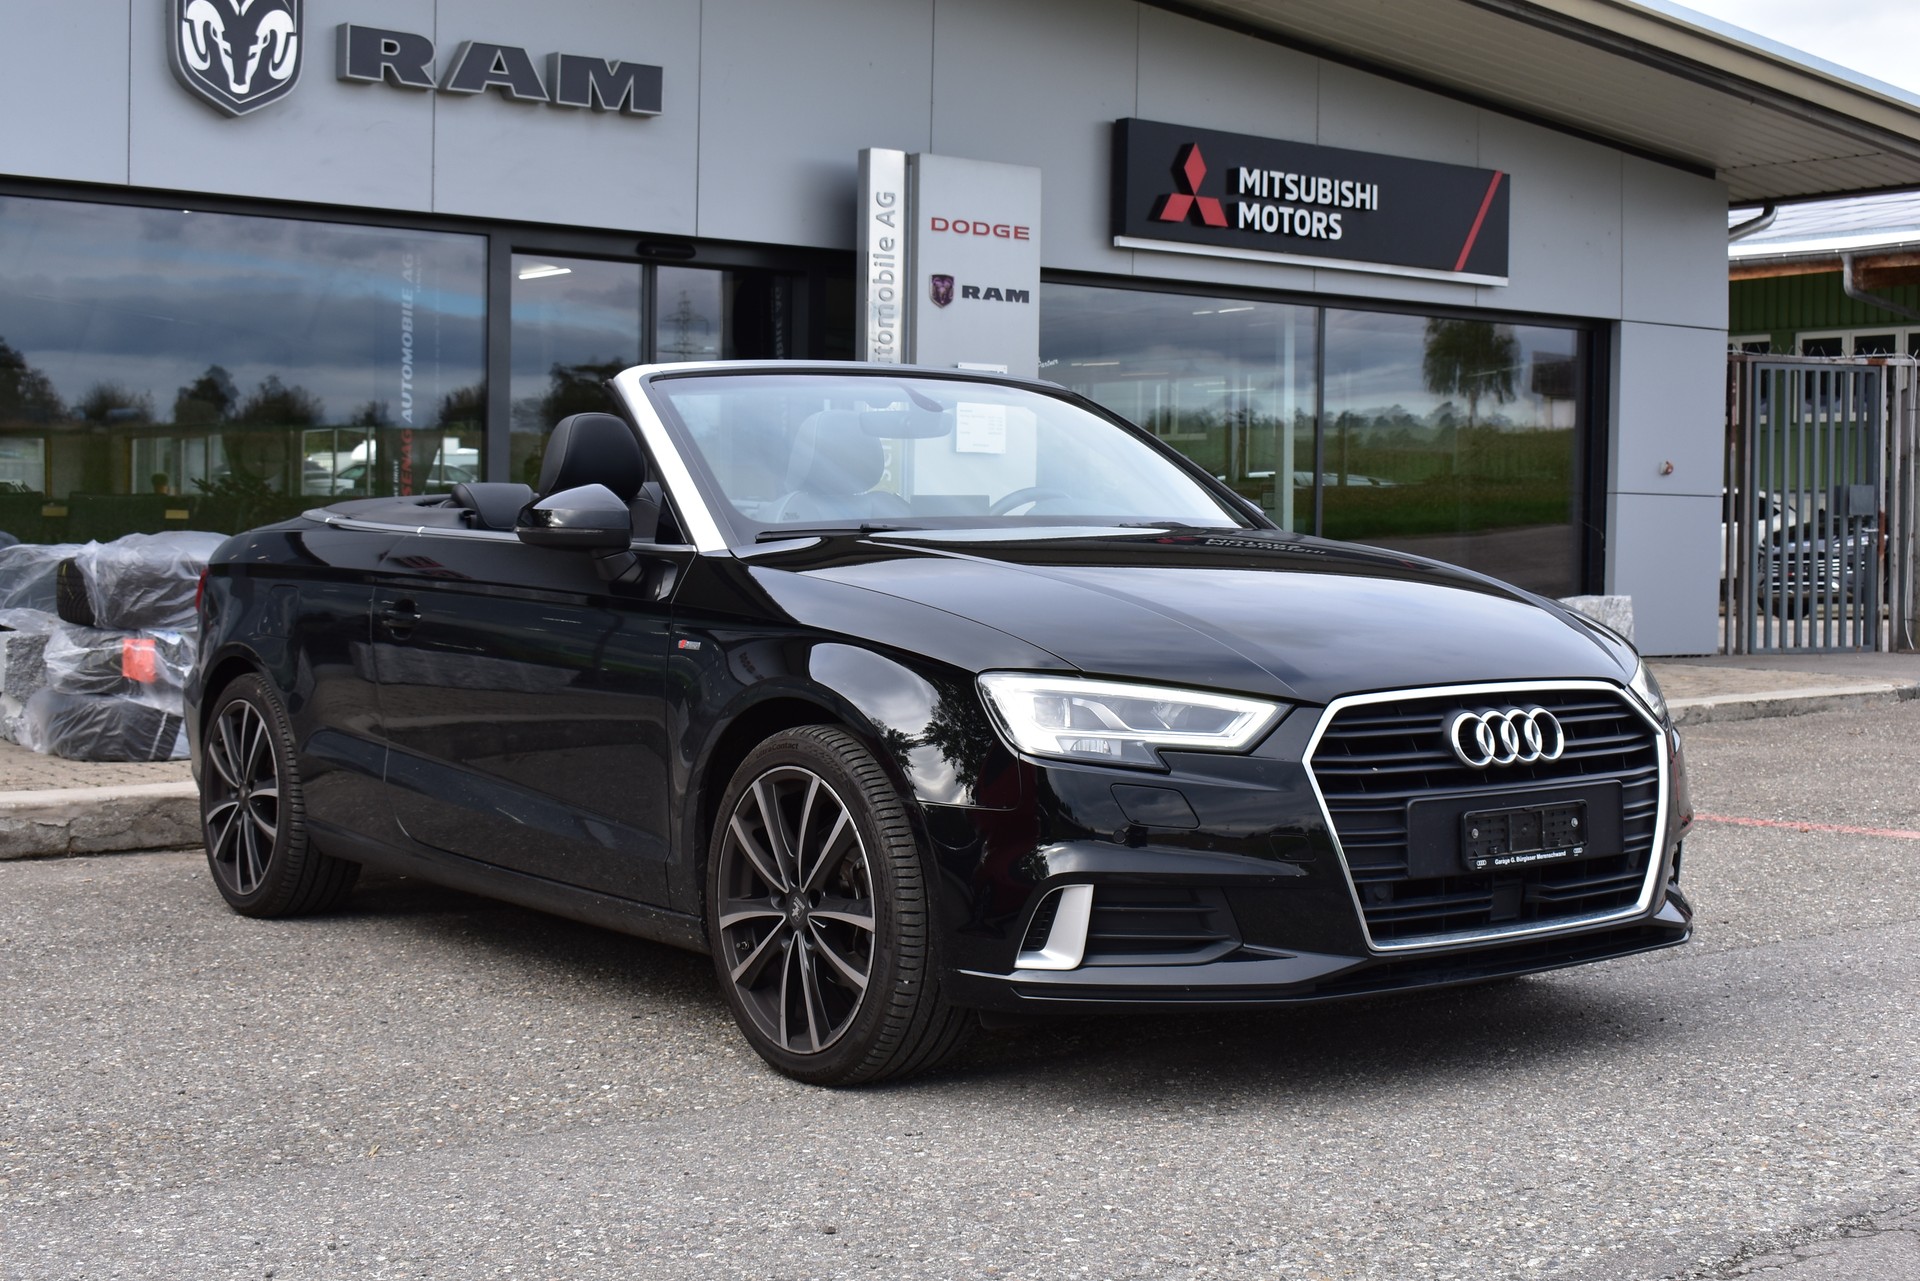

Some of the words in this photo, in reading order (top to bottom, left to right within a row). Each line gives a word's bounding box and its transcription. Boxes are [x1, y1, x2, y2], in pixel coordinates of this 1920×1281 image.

[337, 22, 663, 117] RAM
[1239, 166, 1379, 211] MITSUBISHI
[875, 191, 896, 228] AG
[931, 216, 1030, 241] DODGE
[1238, 201, 1343, 240] MOTORS
[962, 285, 1029, 304] RAM
[401, 287, 414, 424] AUTOMOBILE
